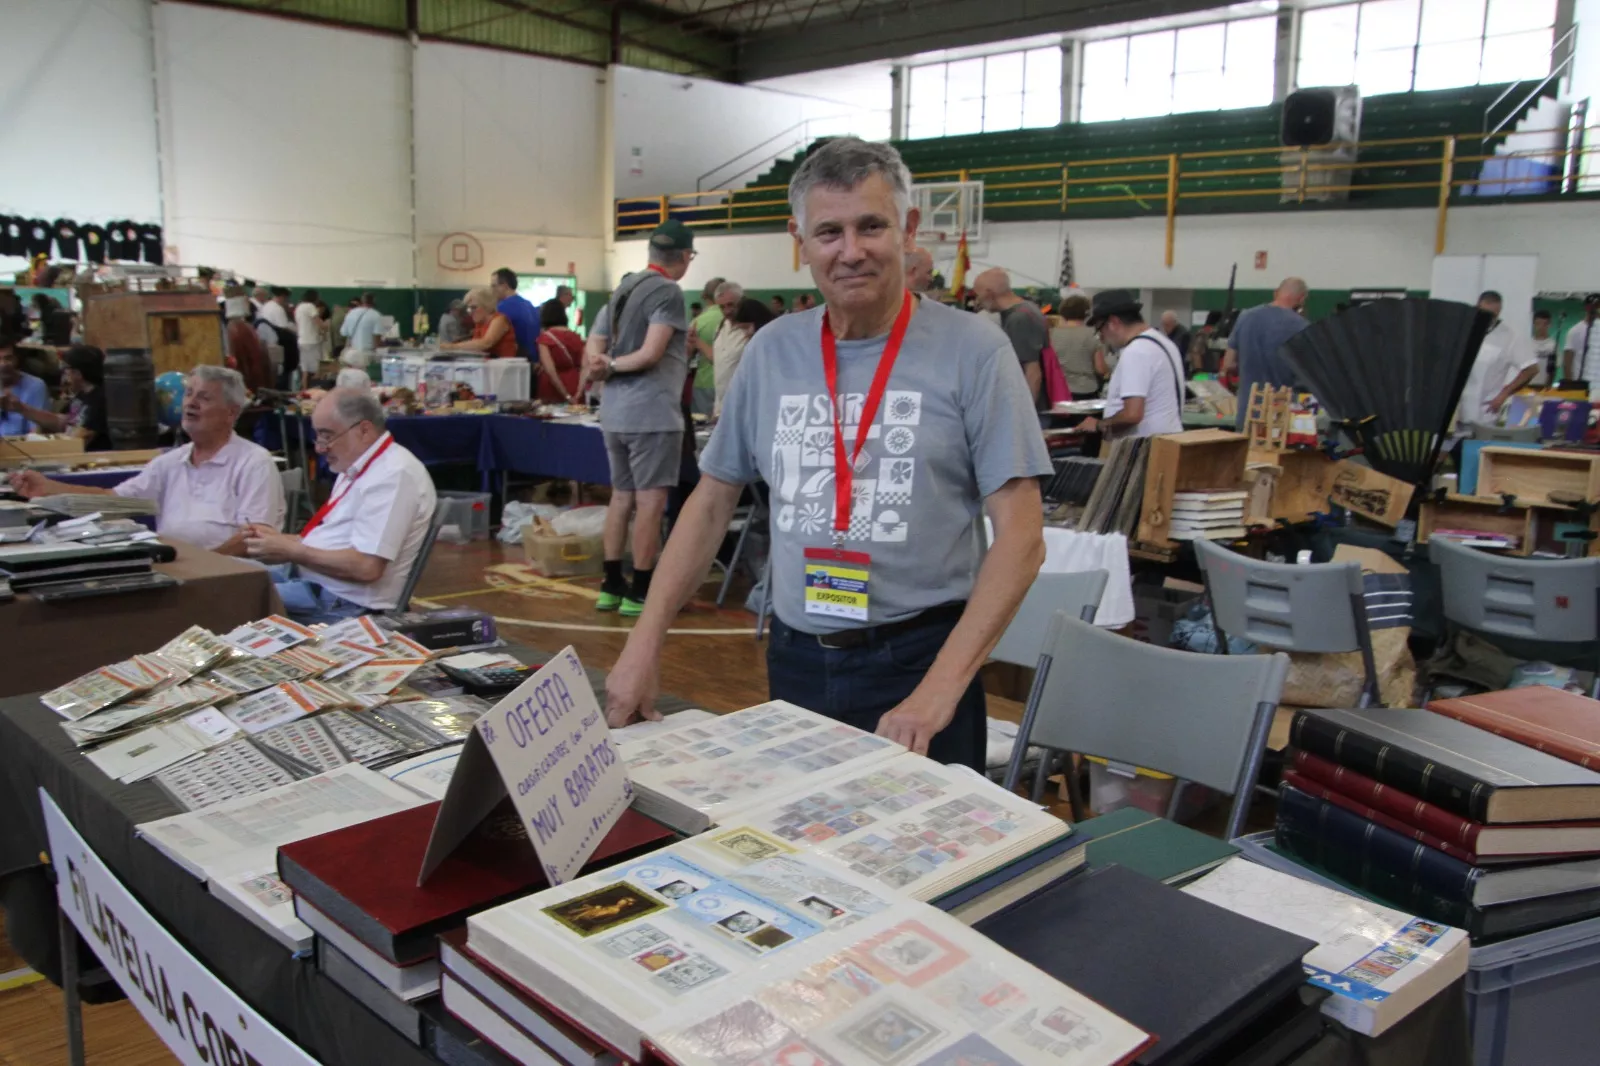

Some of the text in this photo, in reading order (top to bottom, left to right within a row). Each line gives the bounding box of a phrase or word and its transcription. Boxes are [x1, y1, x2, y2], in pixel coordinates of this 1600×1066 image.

[810, 393, 866, 425] SUR
[816, 592, 858, 605] EXPOSITOR
[505, 672, 576, 749] OFERTA
[531, 738, 617, 846] MUY BARATOS
[66, 854, 187, 1041] FILATELIA
